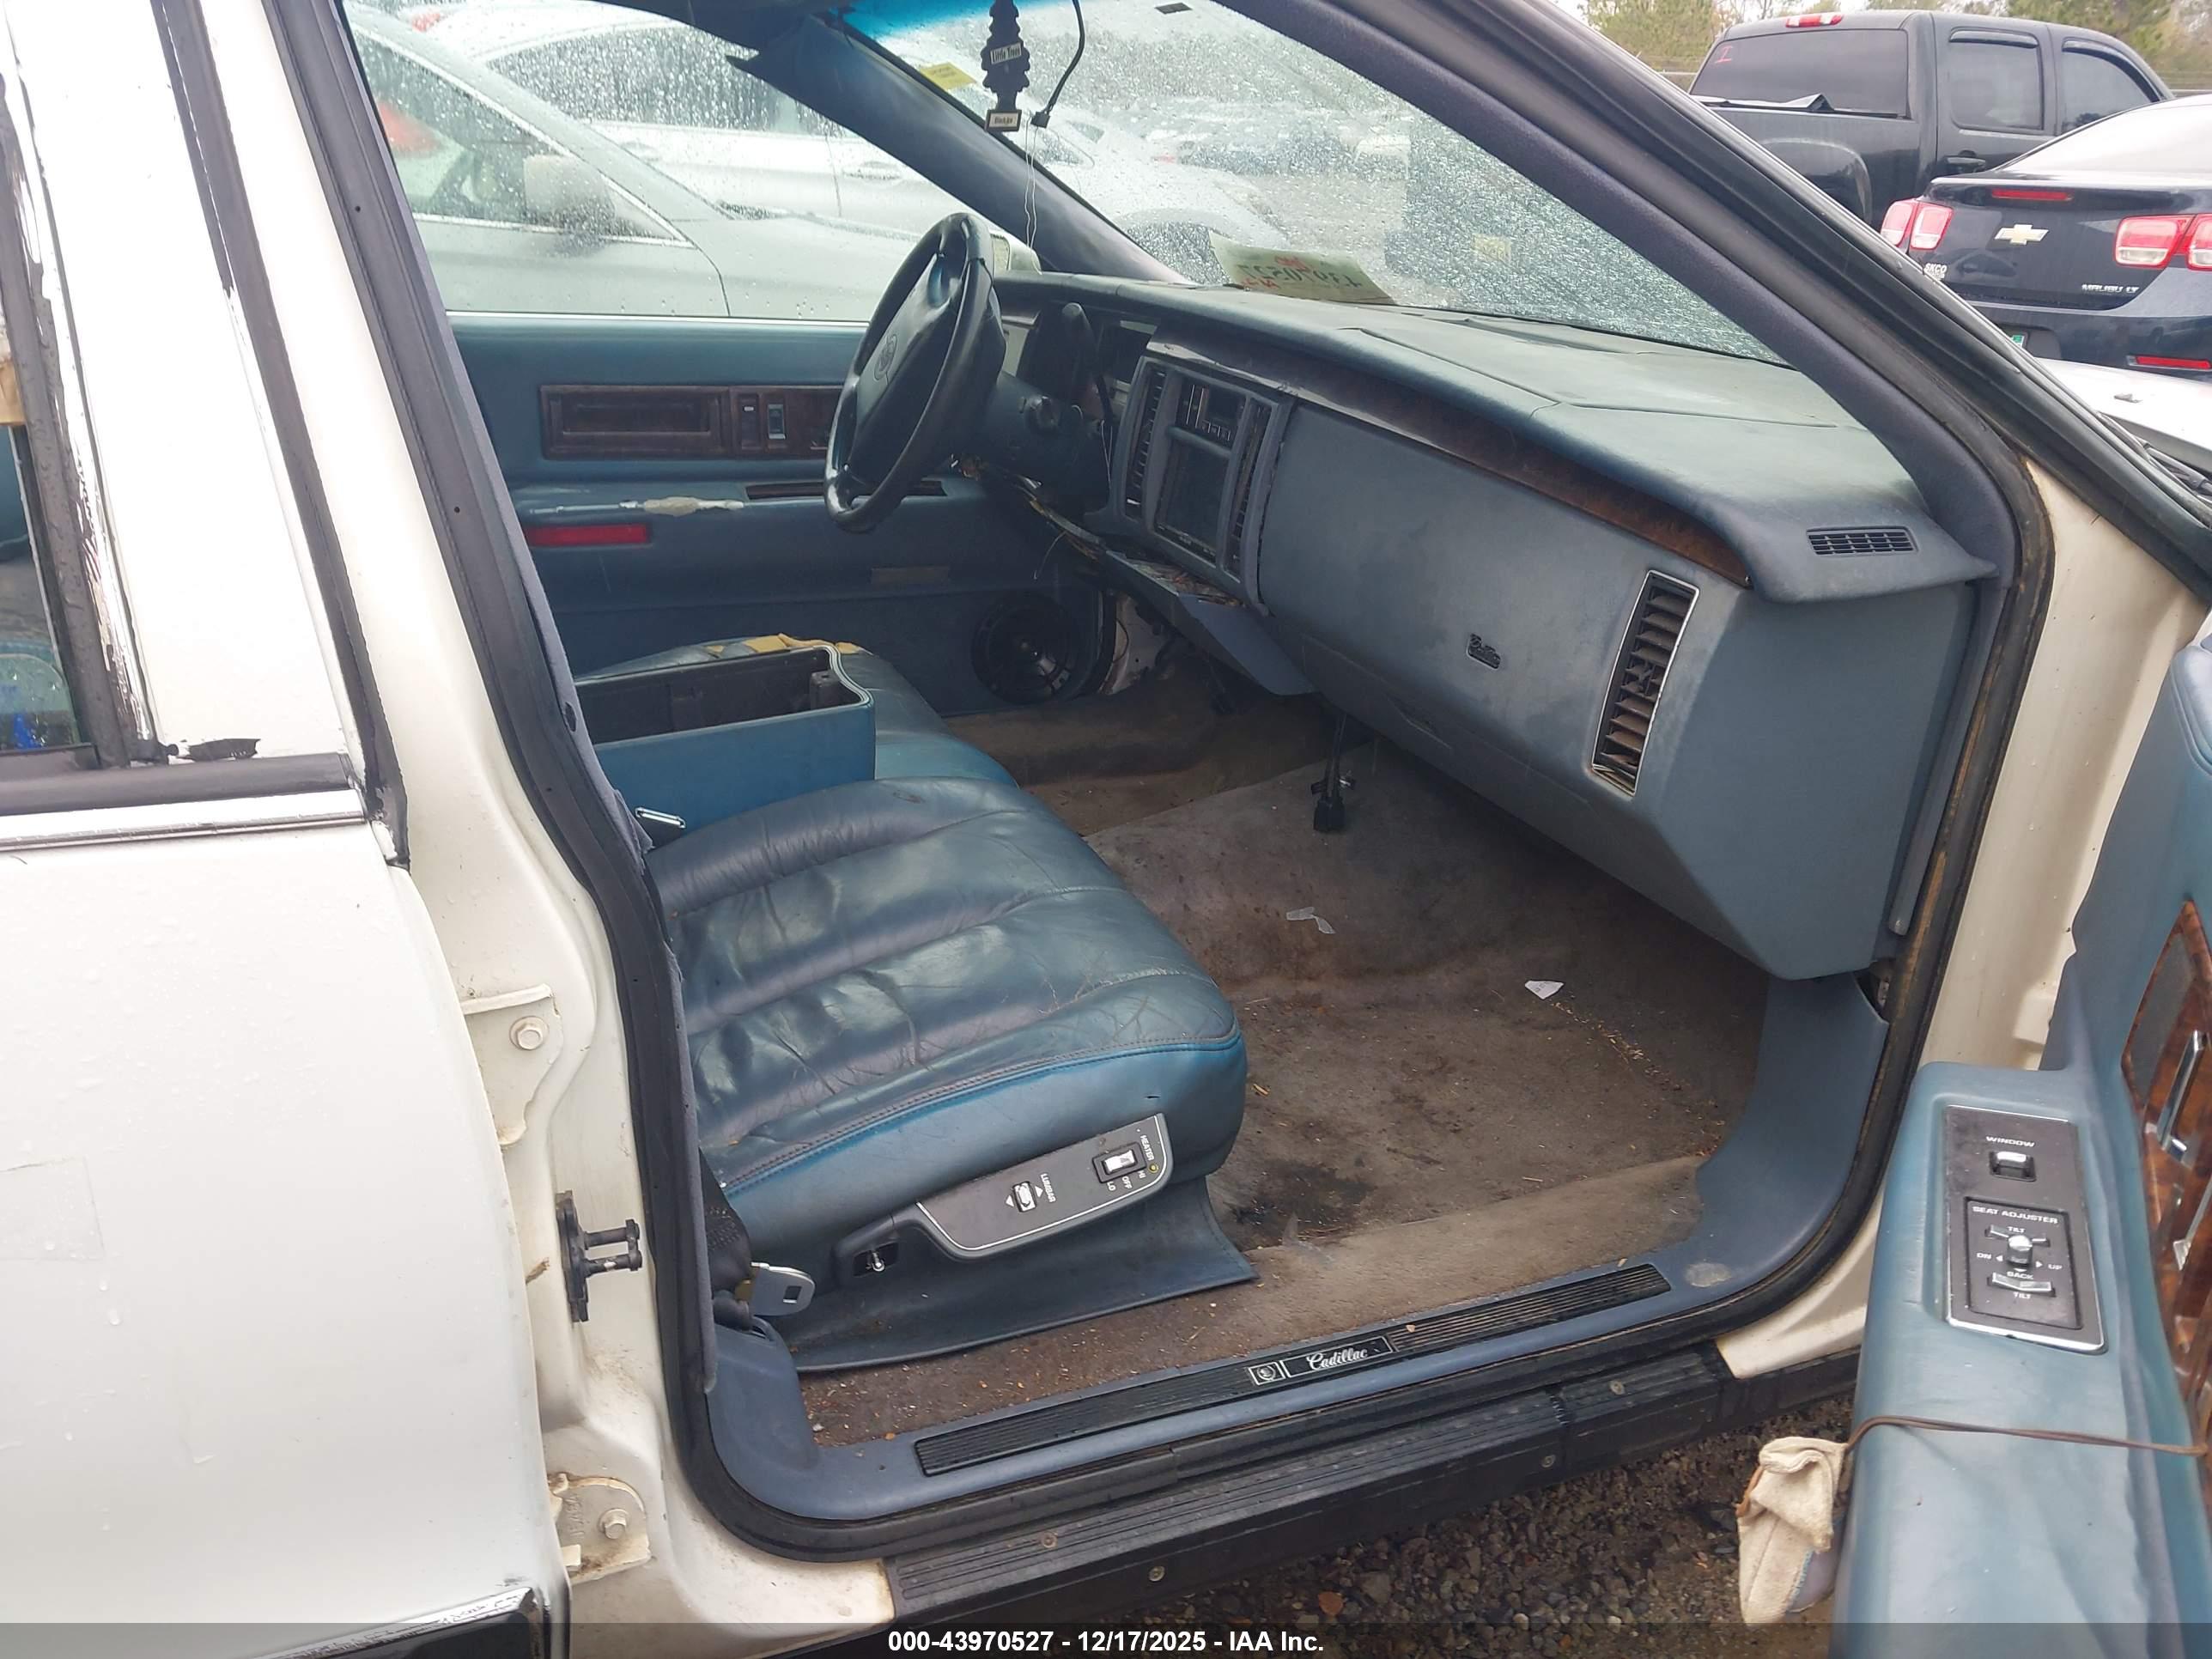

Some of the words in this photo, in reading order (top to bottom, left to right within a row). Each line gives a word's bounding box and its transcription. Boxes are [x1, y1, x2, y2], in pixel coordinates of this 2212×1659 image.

[1985, 1135, 2035, 1147] WINDOW
[1139, 1134, 1155, 1161] HEATER
[1138, 1170, 1147, 1179] HI
[1040, 1173, 1056, 1203] LUMBAR
[1107, 1181, 1116, 1192] LO
[1121, 1176, 1133, 1189] OFF
[1972, 1206, 1999, 1215] SEAT
[2002, 1210, 2058, 1224] ADJUSTER
[2007, 1225, 2026, 1234] TILT
[2006, 1271, 2034, 1280] BACK
[2013, 1291, 2032, 1299] TILT
[1305, 1347, 1369, 1371] Cadillac
